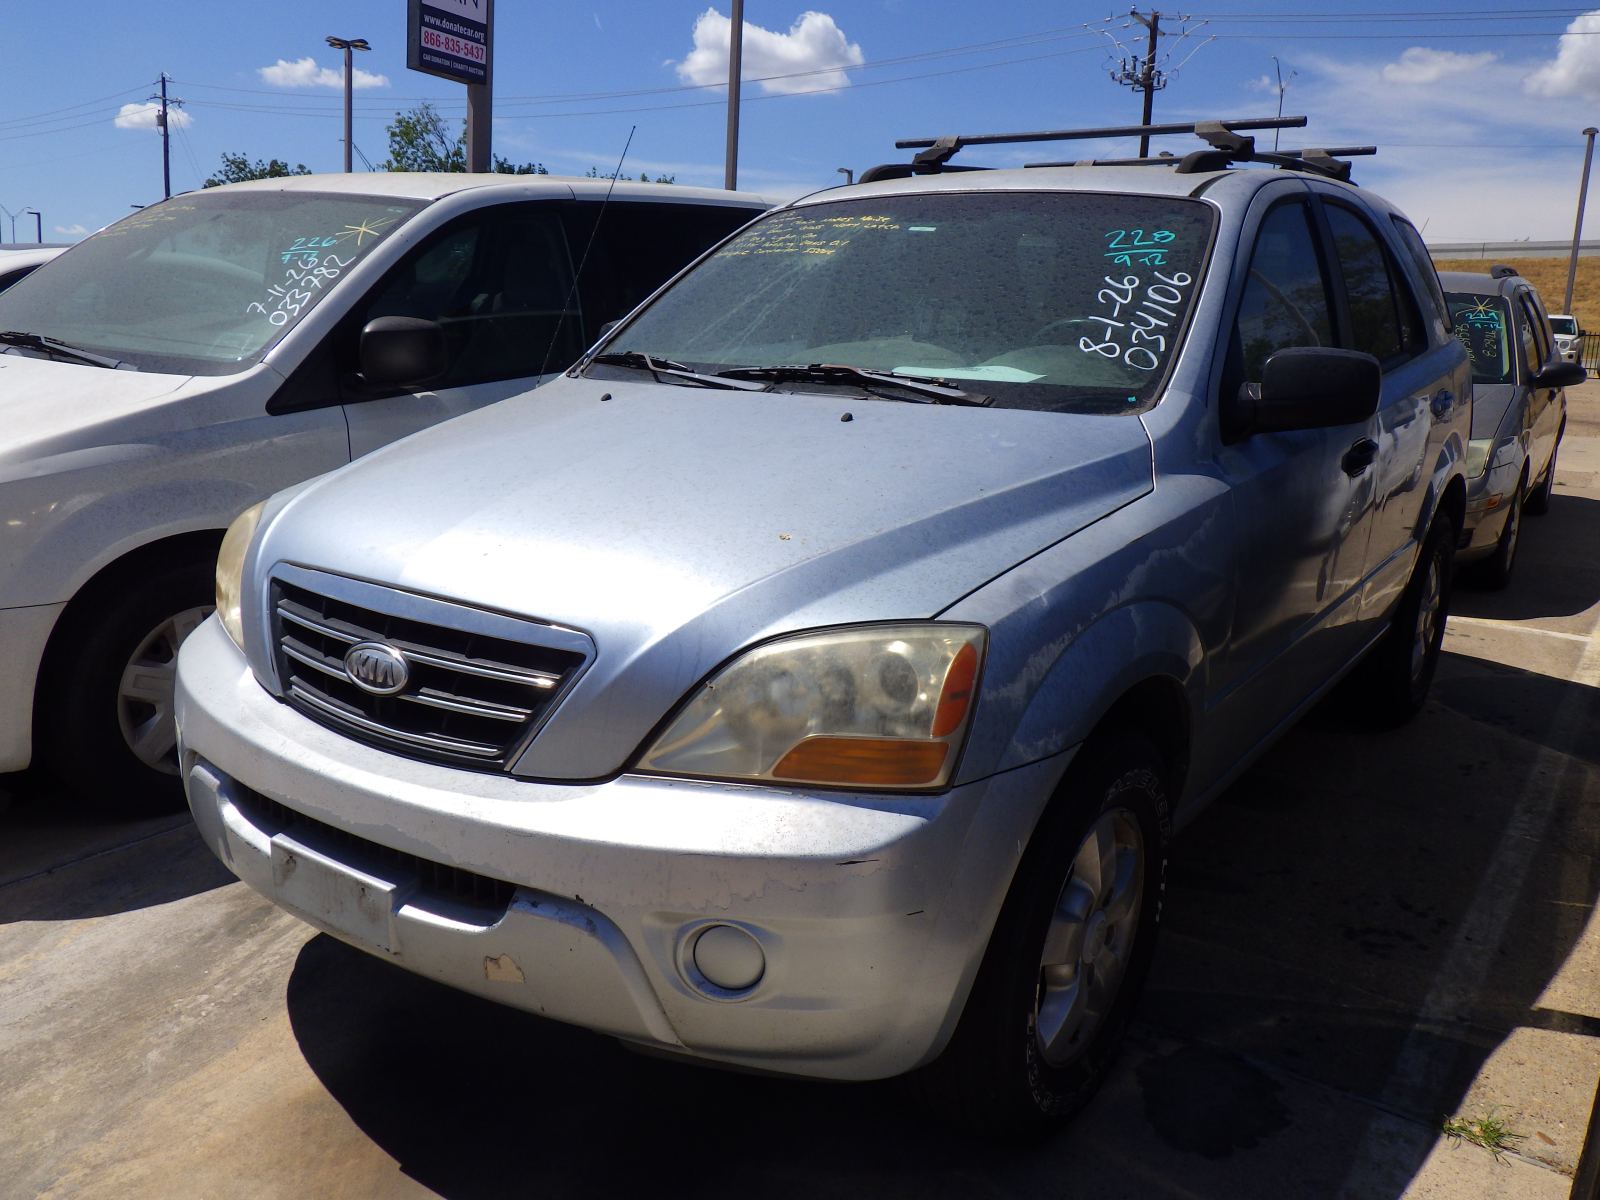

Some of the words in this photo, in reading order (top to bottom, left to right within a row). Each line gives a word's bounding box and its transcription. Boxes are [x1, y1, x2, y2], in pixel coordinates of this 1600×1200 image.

[424, 14, 485, 43] www.donatecar.org
[423, 30, 484, 61] 866-835-5437
[290, 236, 336, 250] 226
[1104, 229, 1176, 248] 228
[1079, 275, 1140, 358] 8-1-26
[1124, 271, 1192, 370] 034106
[351, 652, 395, 686] KIA
